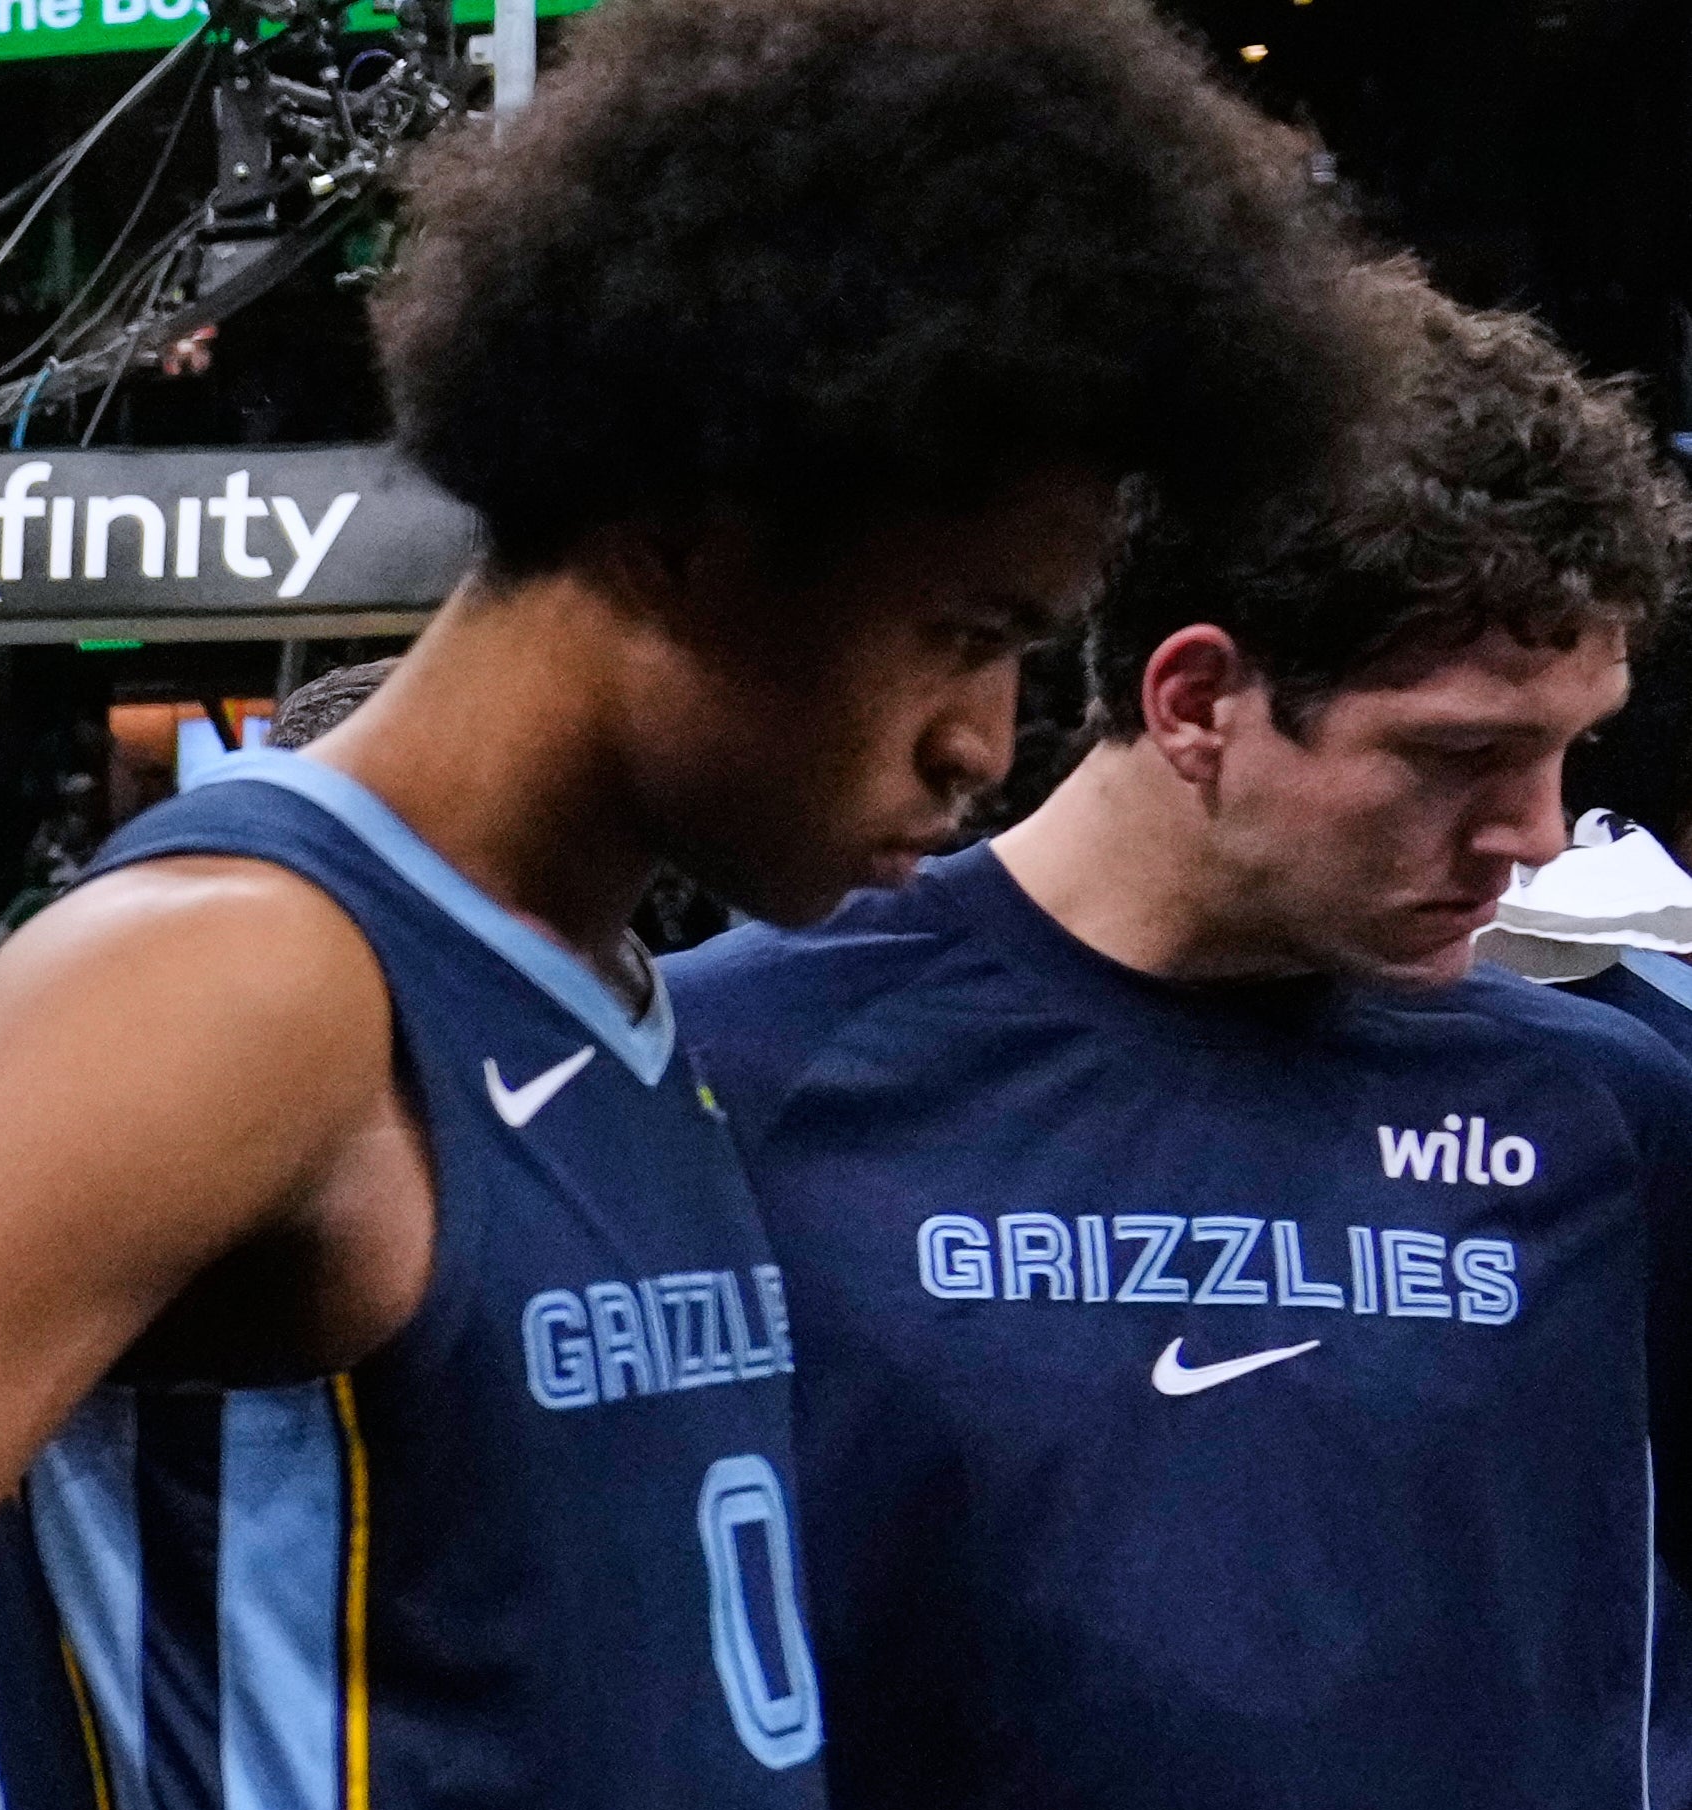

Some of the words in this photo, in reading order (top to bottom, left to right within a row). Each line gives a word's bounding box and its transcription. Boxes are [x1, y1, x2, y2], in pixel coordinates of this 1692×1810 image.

[1377, 1114, 1537, 1187] wilo
[916, 1212, 1521, 1326] GRIZZLIES
[698, 1454, 823, 1771] 0
